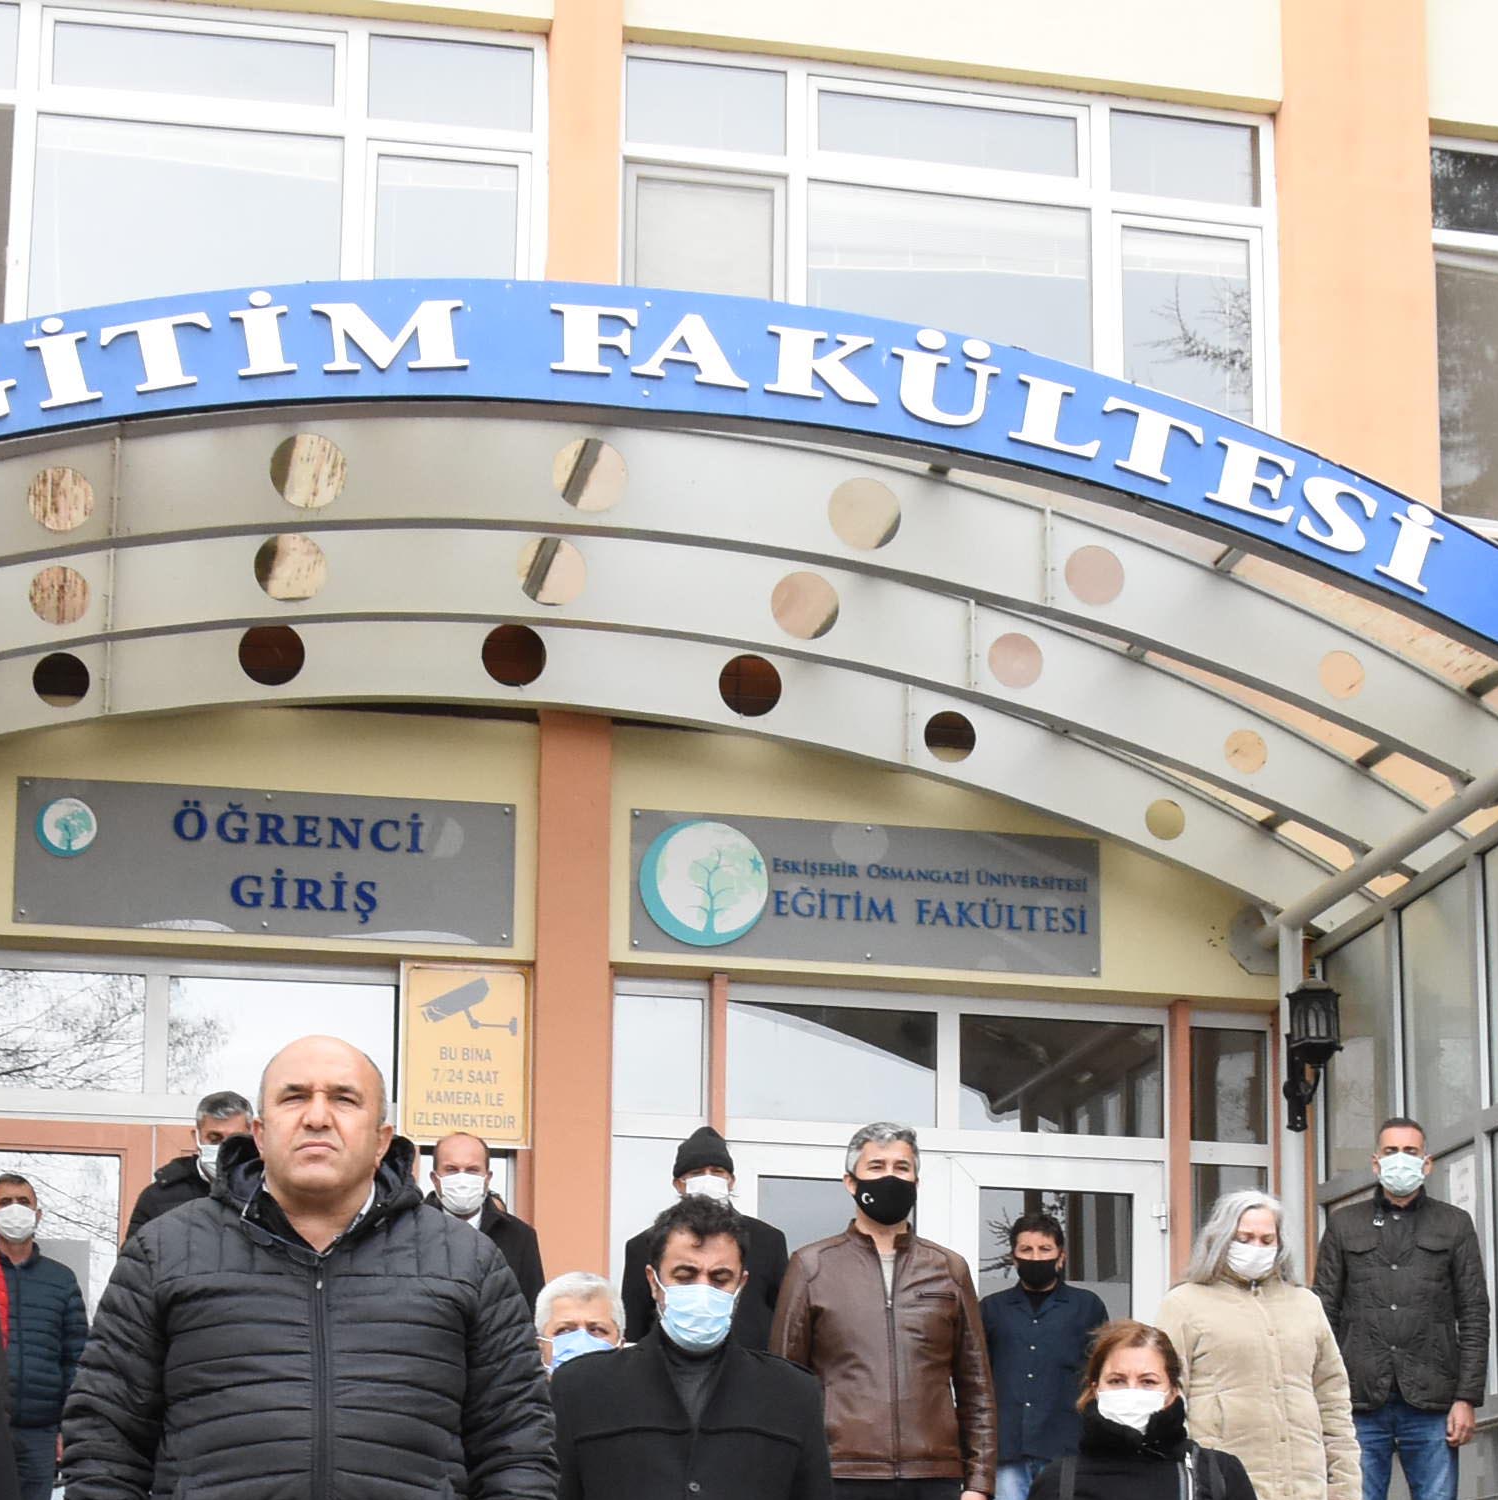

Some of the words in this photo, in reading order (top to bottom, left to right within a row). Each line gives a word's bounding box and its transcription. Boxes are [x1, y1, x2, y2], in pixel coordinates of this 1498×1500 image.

[549, 302, 1446, 595] FAKÜLTESİ
[172, 800, 425, 854] ÖĞRENCİ
[229, 868, 379, 924] GİRİŞ
[772, 885, 897, 924] EĞİTİM
[914, 896, 1088, 935] FAKÜLTESİ
[439, 1046, 457, 1061] BU
[467, 1070, 499, 1084] SAAT
[426, 1090, 481, 1105] KAMERA
